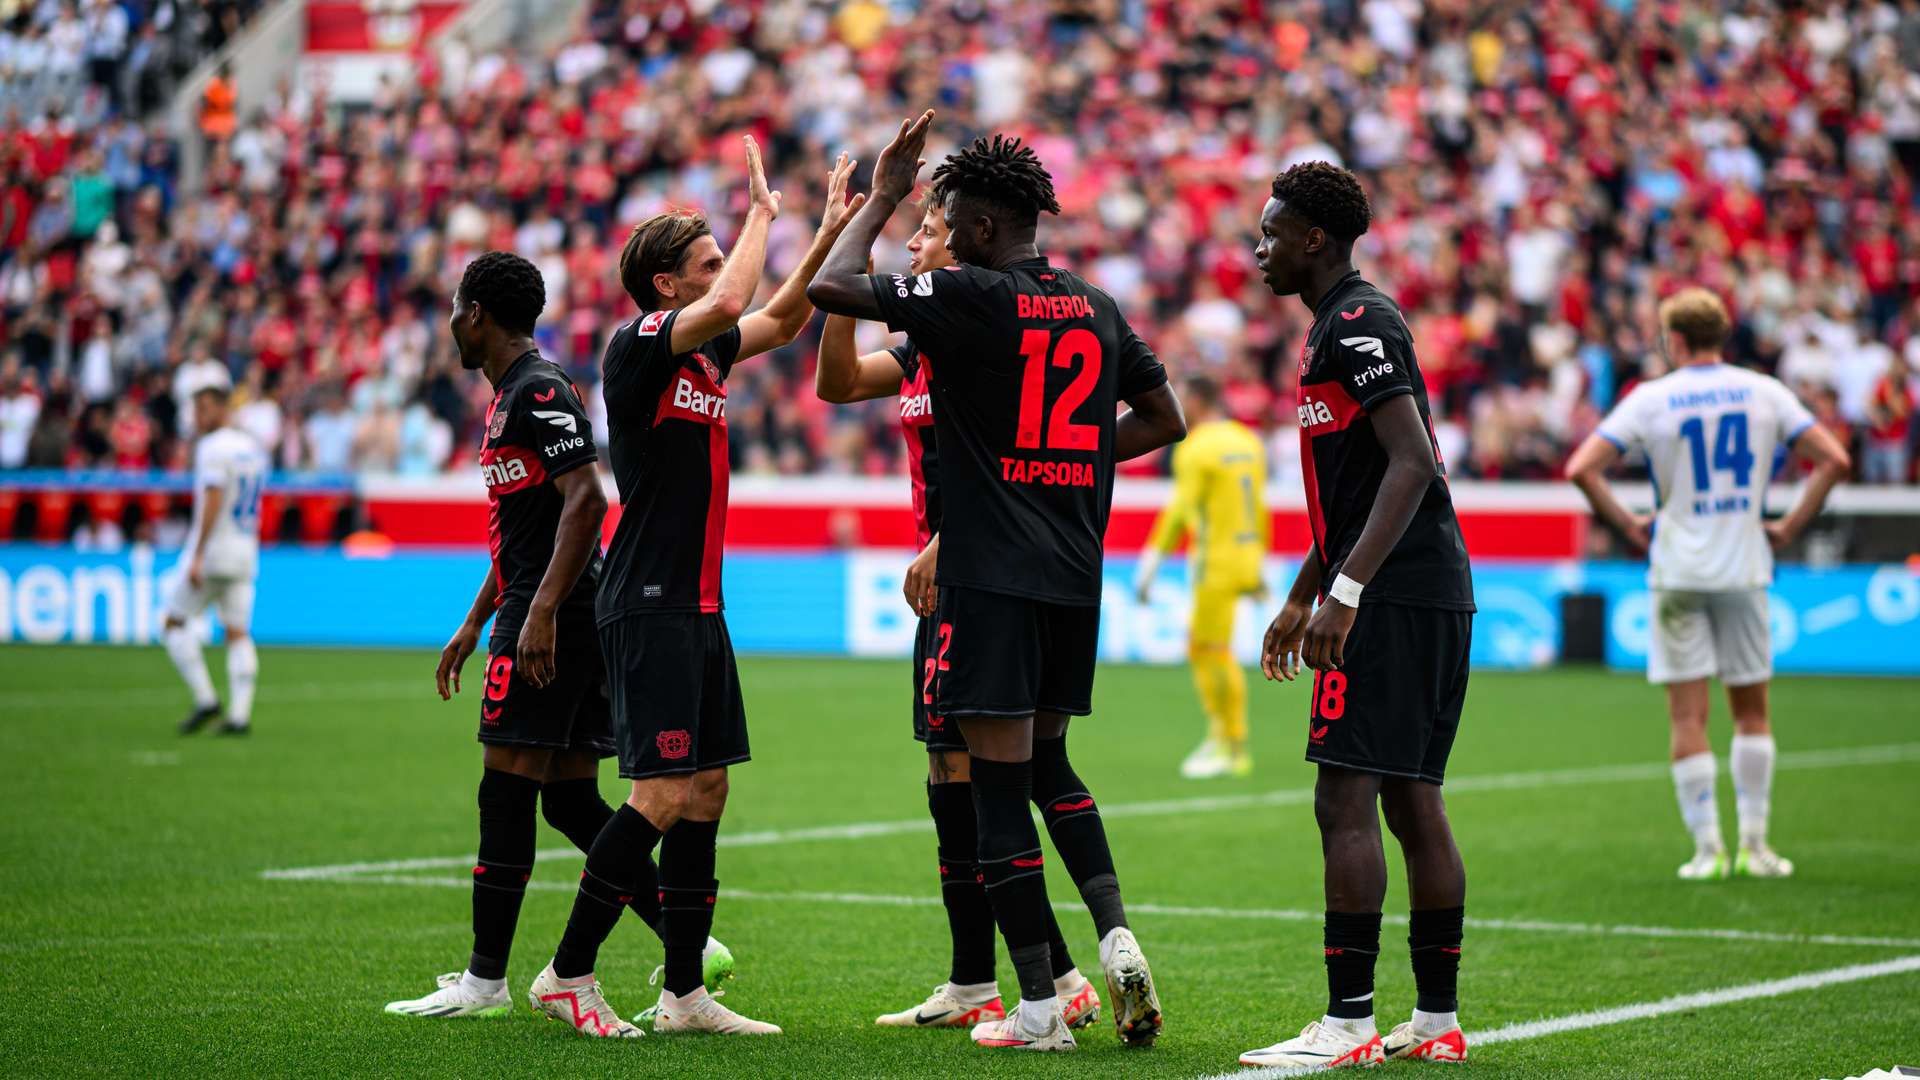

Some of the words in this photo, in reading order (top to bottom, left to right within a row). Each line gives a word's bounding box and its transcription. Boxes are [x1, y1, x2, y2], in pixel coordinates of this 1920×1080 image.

[1015, 329, 1103, 451] 12
[1354, 363, 1394, 387] trive
[544, 437, 585, 457] trive
[1680, 411, 1754, 491] 14
[1000, 457, 1095, 488] TAPSOBA
